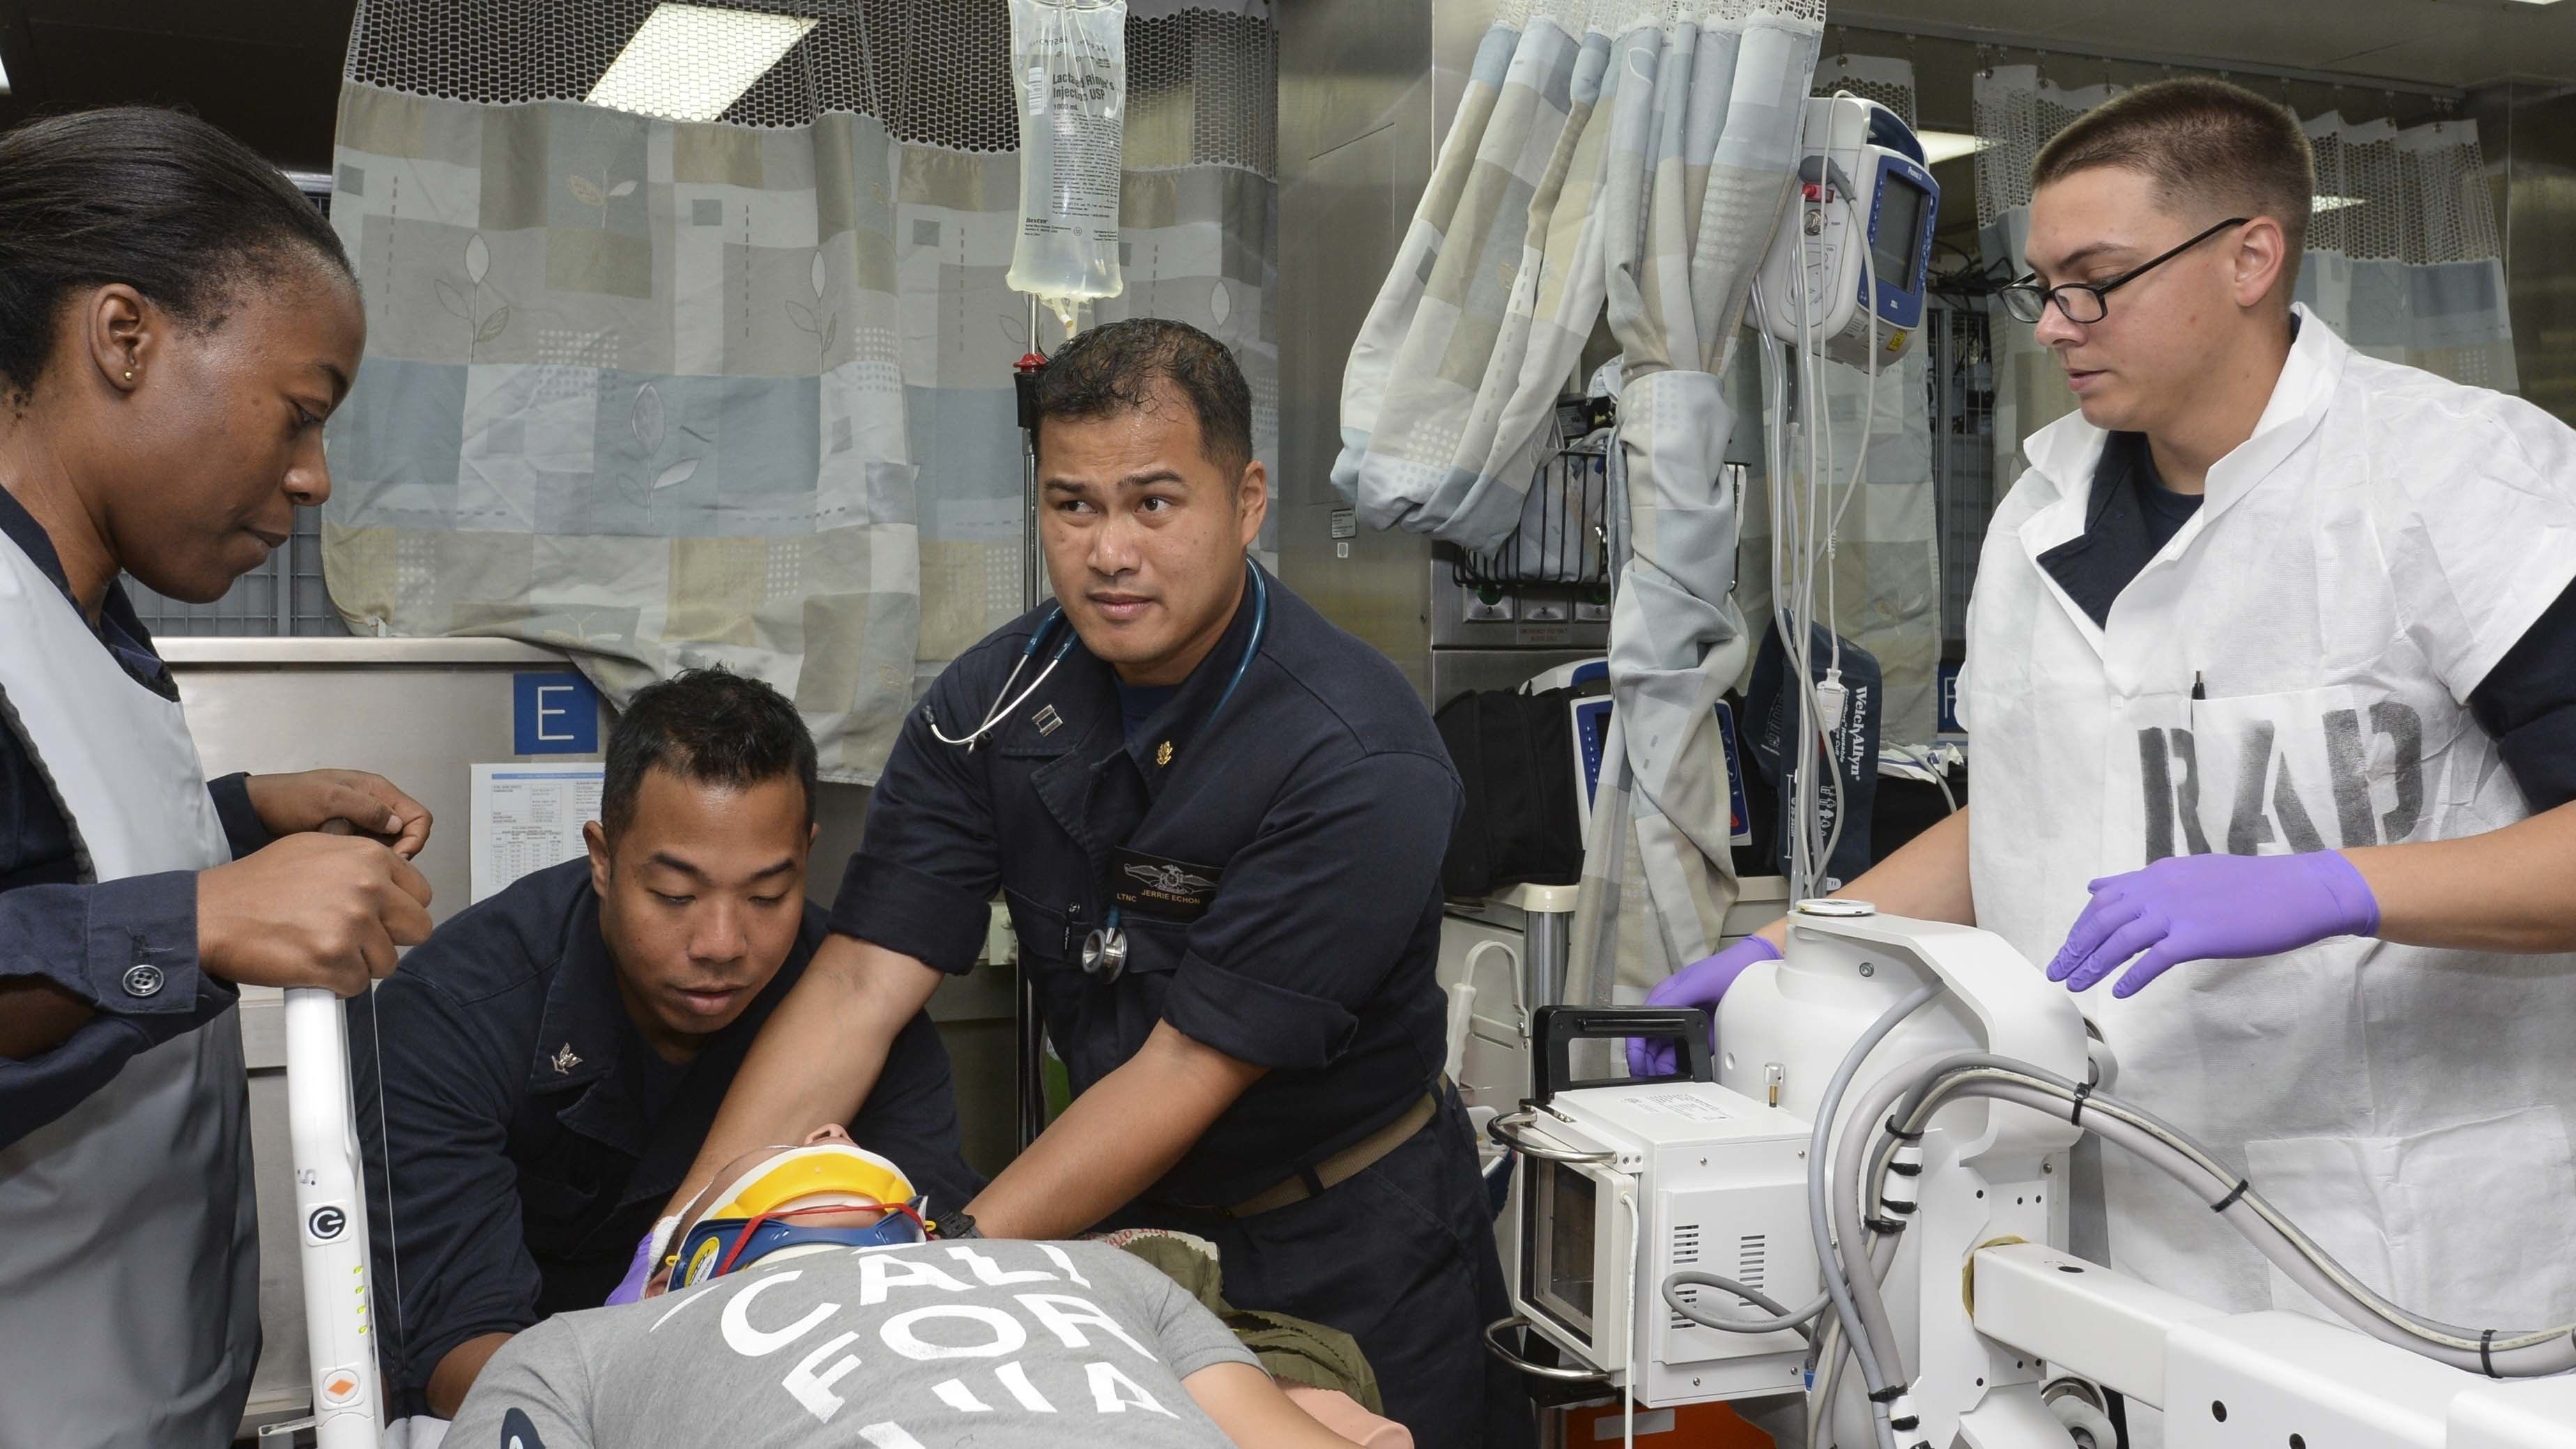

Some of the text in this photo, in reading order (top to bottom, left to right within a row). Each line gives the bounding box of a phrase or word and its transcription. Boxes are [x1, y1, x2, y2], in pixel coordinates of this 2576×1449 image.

[1089, 88, 1105, 100] USP
[537, 686, 574, 740] E
[2138, 701, 2424, 866] RAD
[1141, 889, 1200, 905] JERRIE ECHON
[721, 1243, 1092, 1357] CALI
[781, 1294, 1158, 1423] FOR
